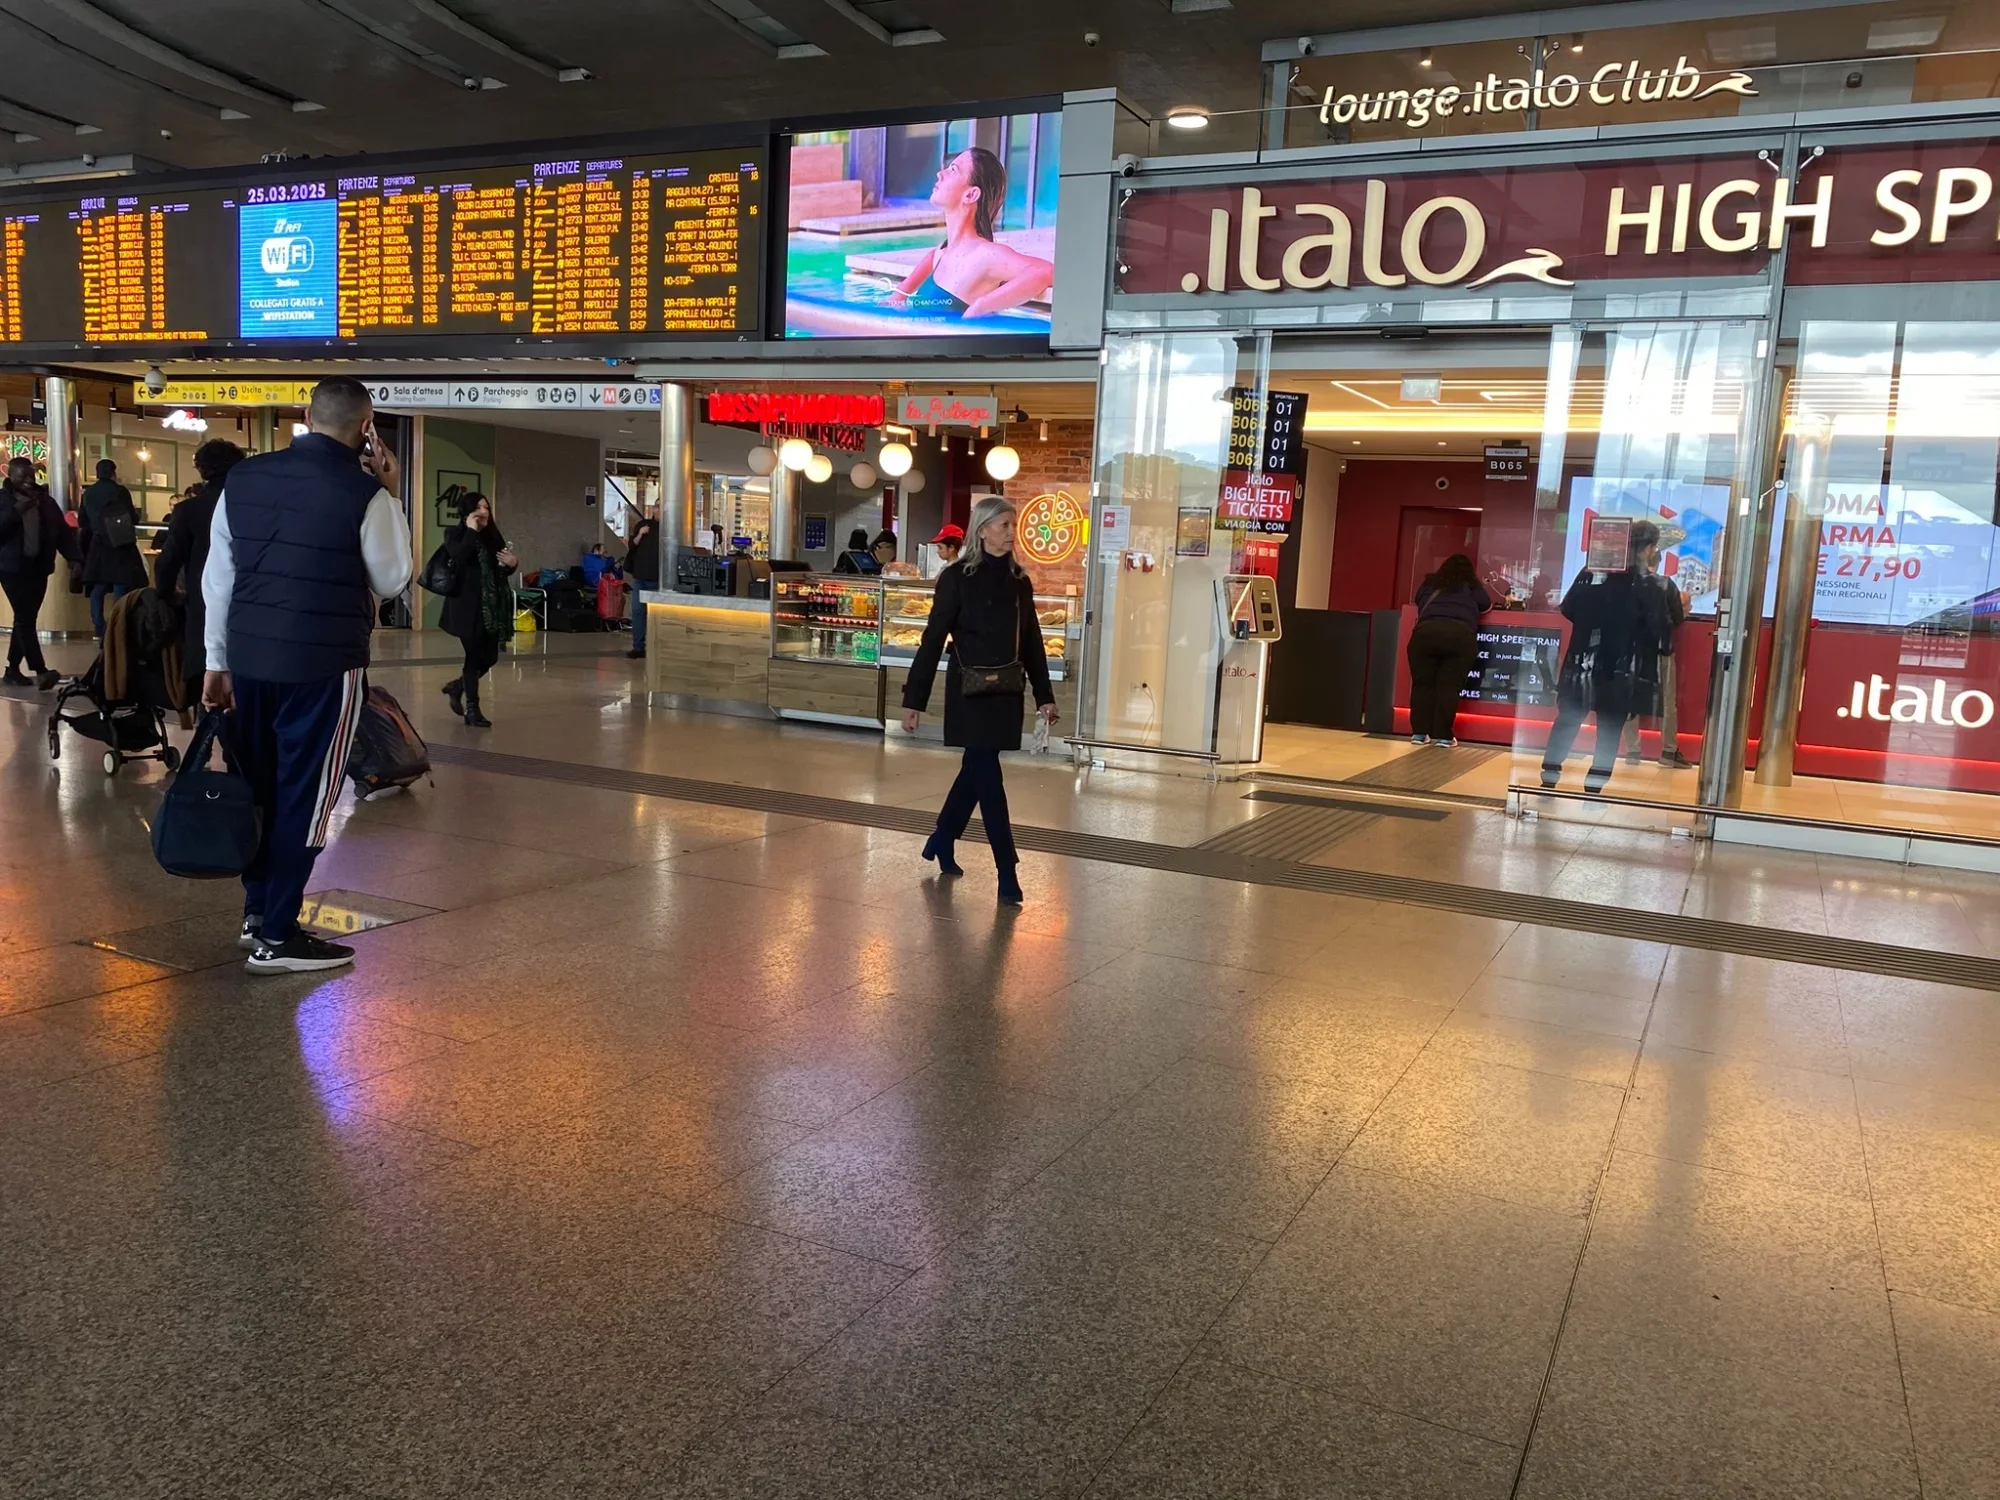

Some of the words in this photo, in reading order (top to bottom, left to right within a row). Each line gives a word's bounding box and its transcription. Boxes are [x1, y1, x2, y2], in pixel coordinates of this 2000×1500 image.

[1319, 85, 1461, 128] lounge
[1588, 56, 1701, 105] Club
[533, 160, 580, 176] PARTENZE
[586, 160, 623, 171] DEPARTURES
[338, 176, 378, 190] PARTENZE
[383, 175, 416, 186] DEPARTURES
[248, 183, 326, 203] 25.03.2025
[586, 192, 606, 202] NAPOLI
[81, 198, 105, 210] ARRIVI
[749, 205, 757, 215] 16
[525, 207, 531, 217] 5
[1604, 174, 1834, 256] HIGH
[1869, 166, 2000, 247] SP
[705, 219, 726, 228] SMART
[249, 298, 289, 309] COLLEGATI
[290, 298, 317, 307] GRATIS
[317, 297, 324, 306] A
[584, 300, 604, 309] NAPOLI
[241, 385, 262, 394] Uscita
[393, 386, 411, 395] Sala
[412, 386, 443, 395] d'attesa
[483, 387, 529, 398] Parcheggio
[925, 396, 992, 428] Bottega
[1276, 402, 1293, 415] 01
[1273, 420, 1290, 433] 01
[1271, 438, 1287, 451] 01
[1269, 456, 1285, 469] 01
[1490, 460, 1523, 470] B065
[1224, 486, 1291, 504] BIGLIETTI
[1227, 501, 1284, 519] TICKETS
[1224, 520, 1261, 530] VIAGGIA
[1265, 522, 1285, 531] CON
[1836, 554, 1922, 582] 27,90
[1816, 581, 1860, 590] NESSIONE
[1838, 590, 1887, 600] REGIONALI
[1476, 633, 1500, 643] HIGH
[1501, 634, 1524, 645] SPEE
[1528, 675, 1536, 685] 3
[1459, 689, 1480, 698] PLES
[1528, 695, 1534, 704] 1
